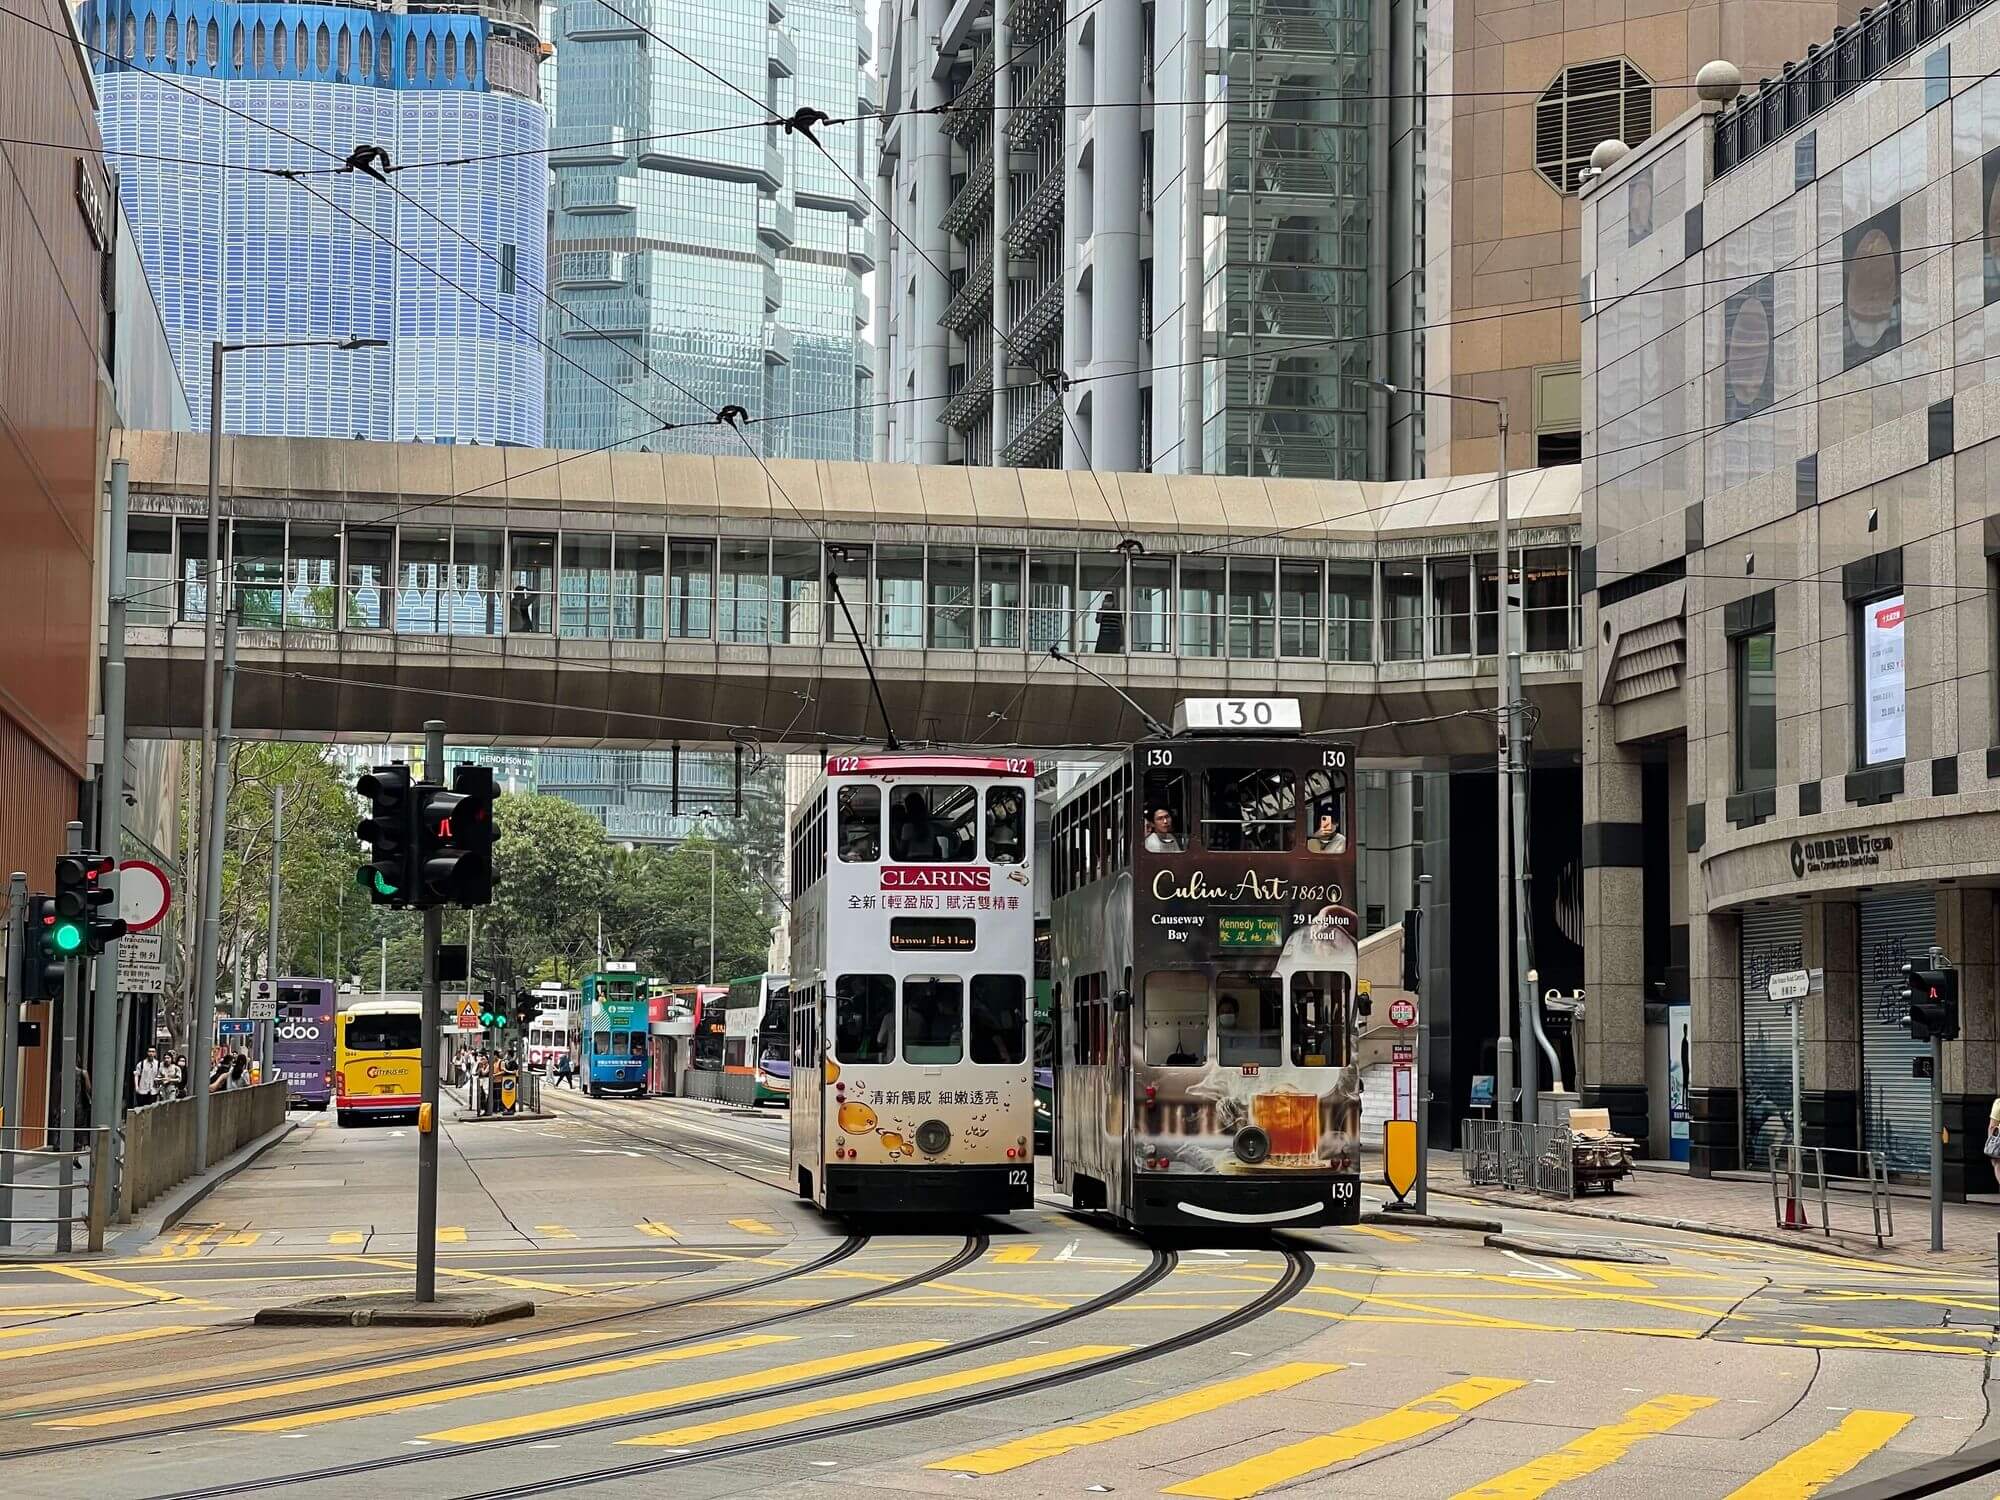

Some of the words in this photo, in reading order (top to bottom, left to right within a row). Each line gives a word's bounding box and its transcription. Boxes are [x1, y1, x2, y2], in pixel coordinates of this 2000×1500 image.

[1216, 702, 1272, 725] 130
[480, 754, 522, 766] HENDERSON
[836, 757, 859, 773] 122
[1147, 750, 1172, 766] 130
[1323, 751, 1345, 767] 130
[1006, 759, 1027, 774] 122
[881, 871, 990, 886] CLARINS
[1152, 870, 1227, 900] Culin
[1229, 870, 1289, 901] Art
[1291, 885, 1324, 900] 1862
[848, 895, 876, 910] 全新
[946, 896, 1020, 910] 賦活雙精華
[1151, 914, 1205, 927] Causeway
[1219, 918, 1254, 930] Kennedy
[1258, 919, 1279, 929] Town
[1293, 914, 1304, 924] 29
[1307, 914, 1350, 927] Leighton
[1168, 930, 1189, 942] Bay
[1310, 930, 1335, 941] Road
[151, 980, 161, 989] 12
[869, 1090, 932, 1105] 清新觸感
[938, 1090, 999, 1105] 細嫩透亮
[1009, 1170, 1027, 1185] 122
[1332, 1183, 1353, 1199] 130
